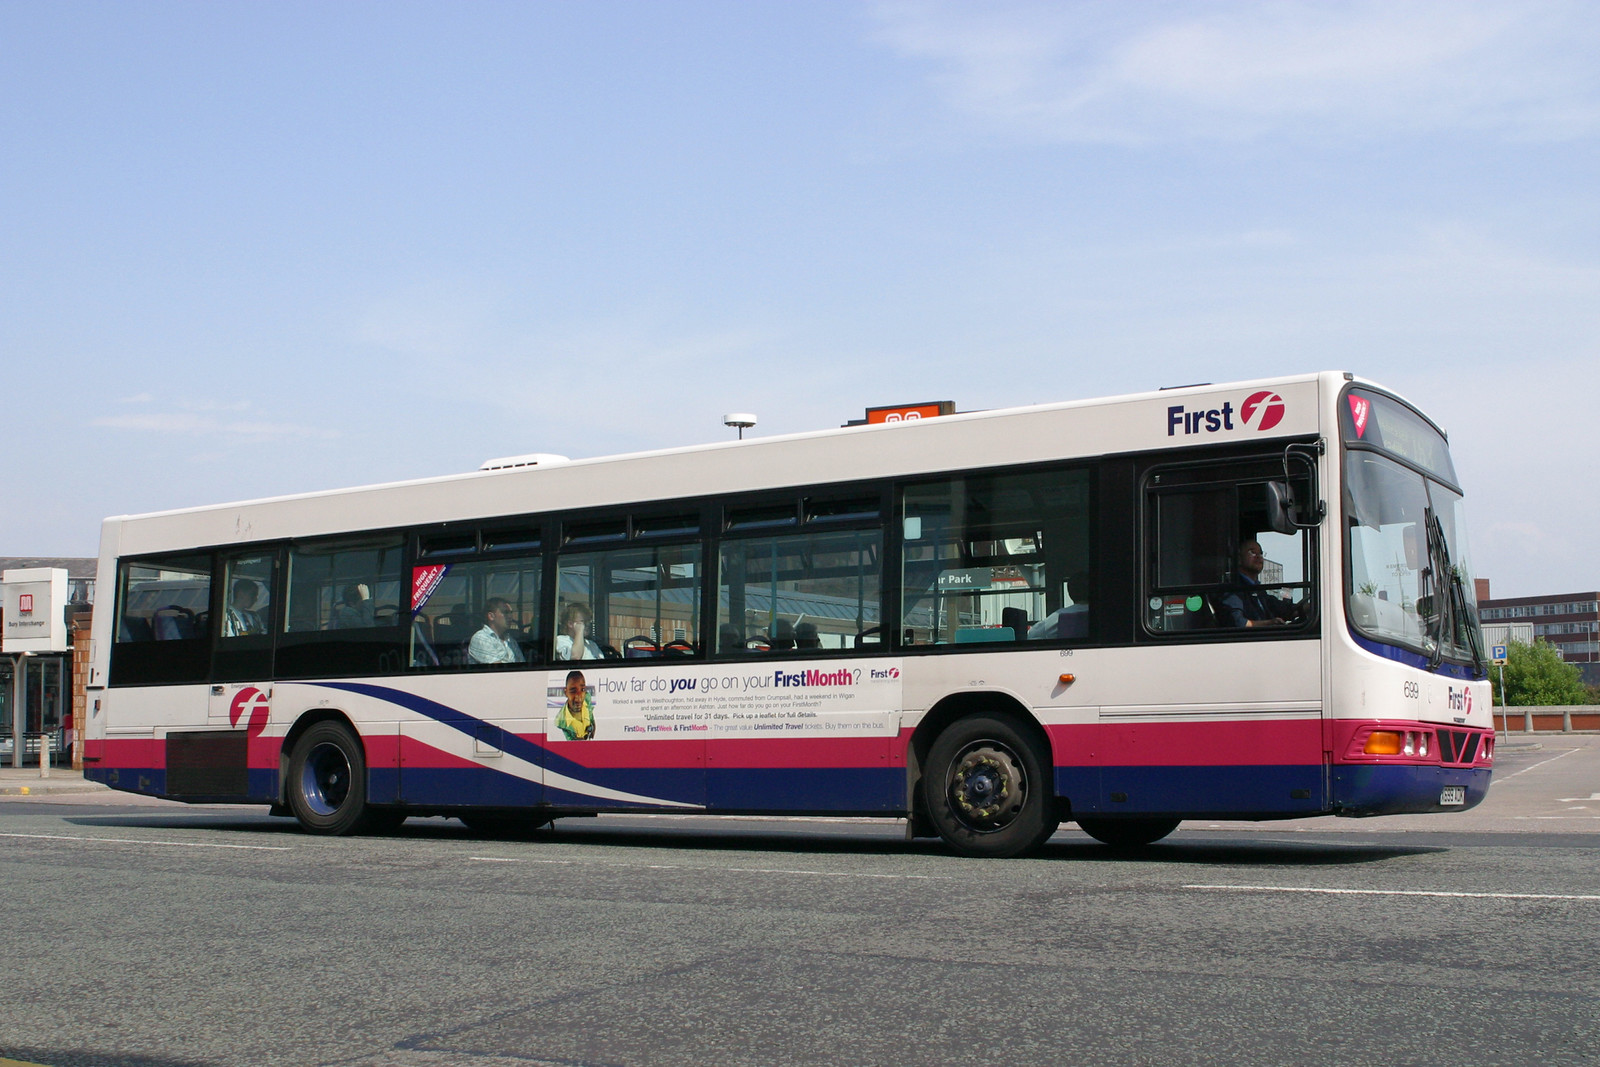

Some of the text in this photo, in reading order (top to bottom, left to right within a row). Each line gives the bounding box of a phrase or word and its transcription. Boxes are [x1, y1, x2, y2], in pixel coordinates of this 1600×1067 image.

[1168, 402, 1233, 436] First
[413, 566, 438, 600] FREQUENCY
[416, 570, 428, 586] HIGH
[948, 574, 972, 584] Park
[1495, 647, 1504, 658] P
[598, 668, 862, 694] How far do you go on your FirstMonth?
[870, 669, 888, 678] First
[1404, 680, 1418, 698] 699
[1448, 686, 1463, 710] First
[825, 722, 836, 730] Buy
